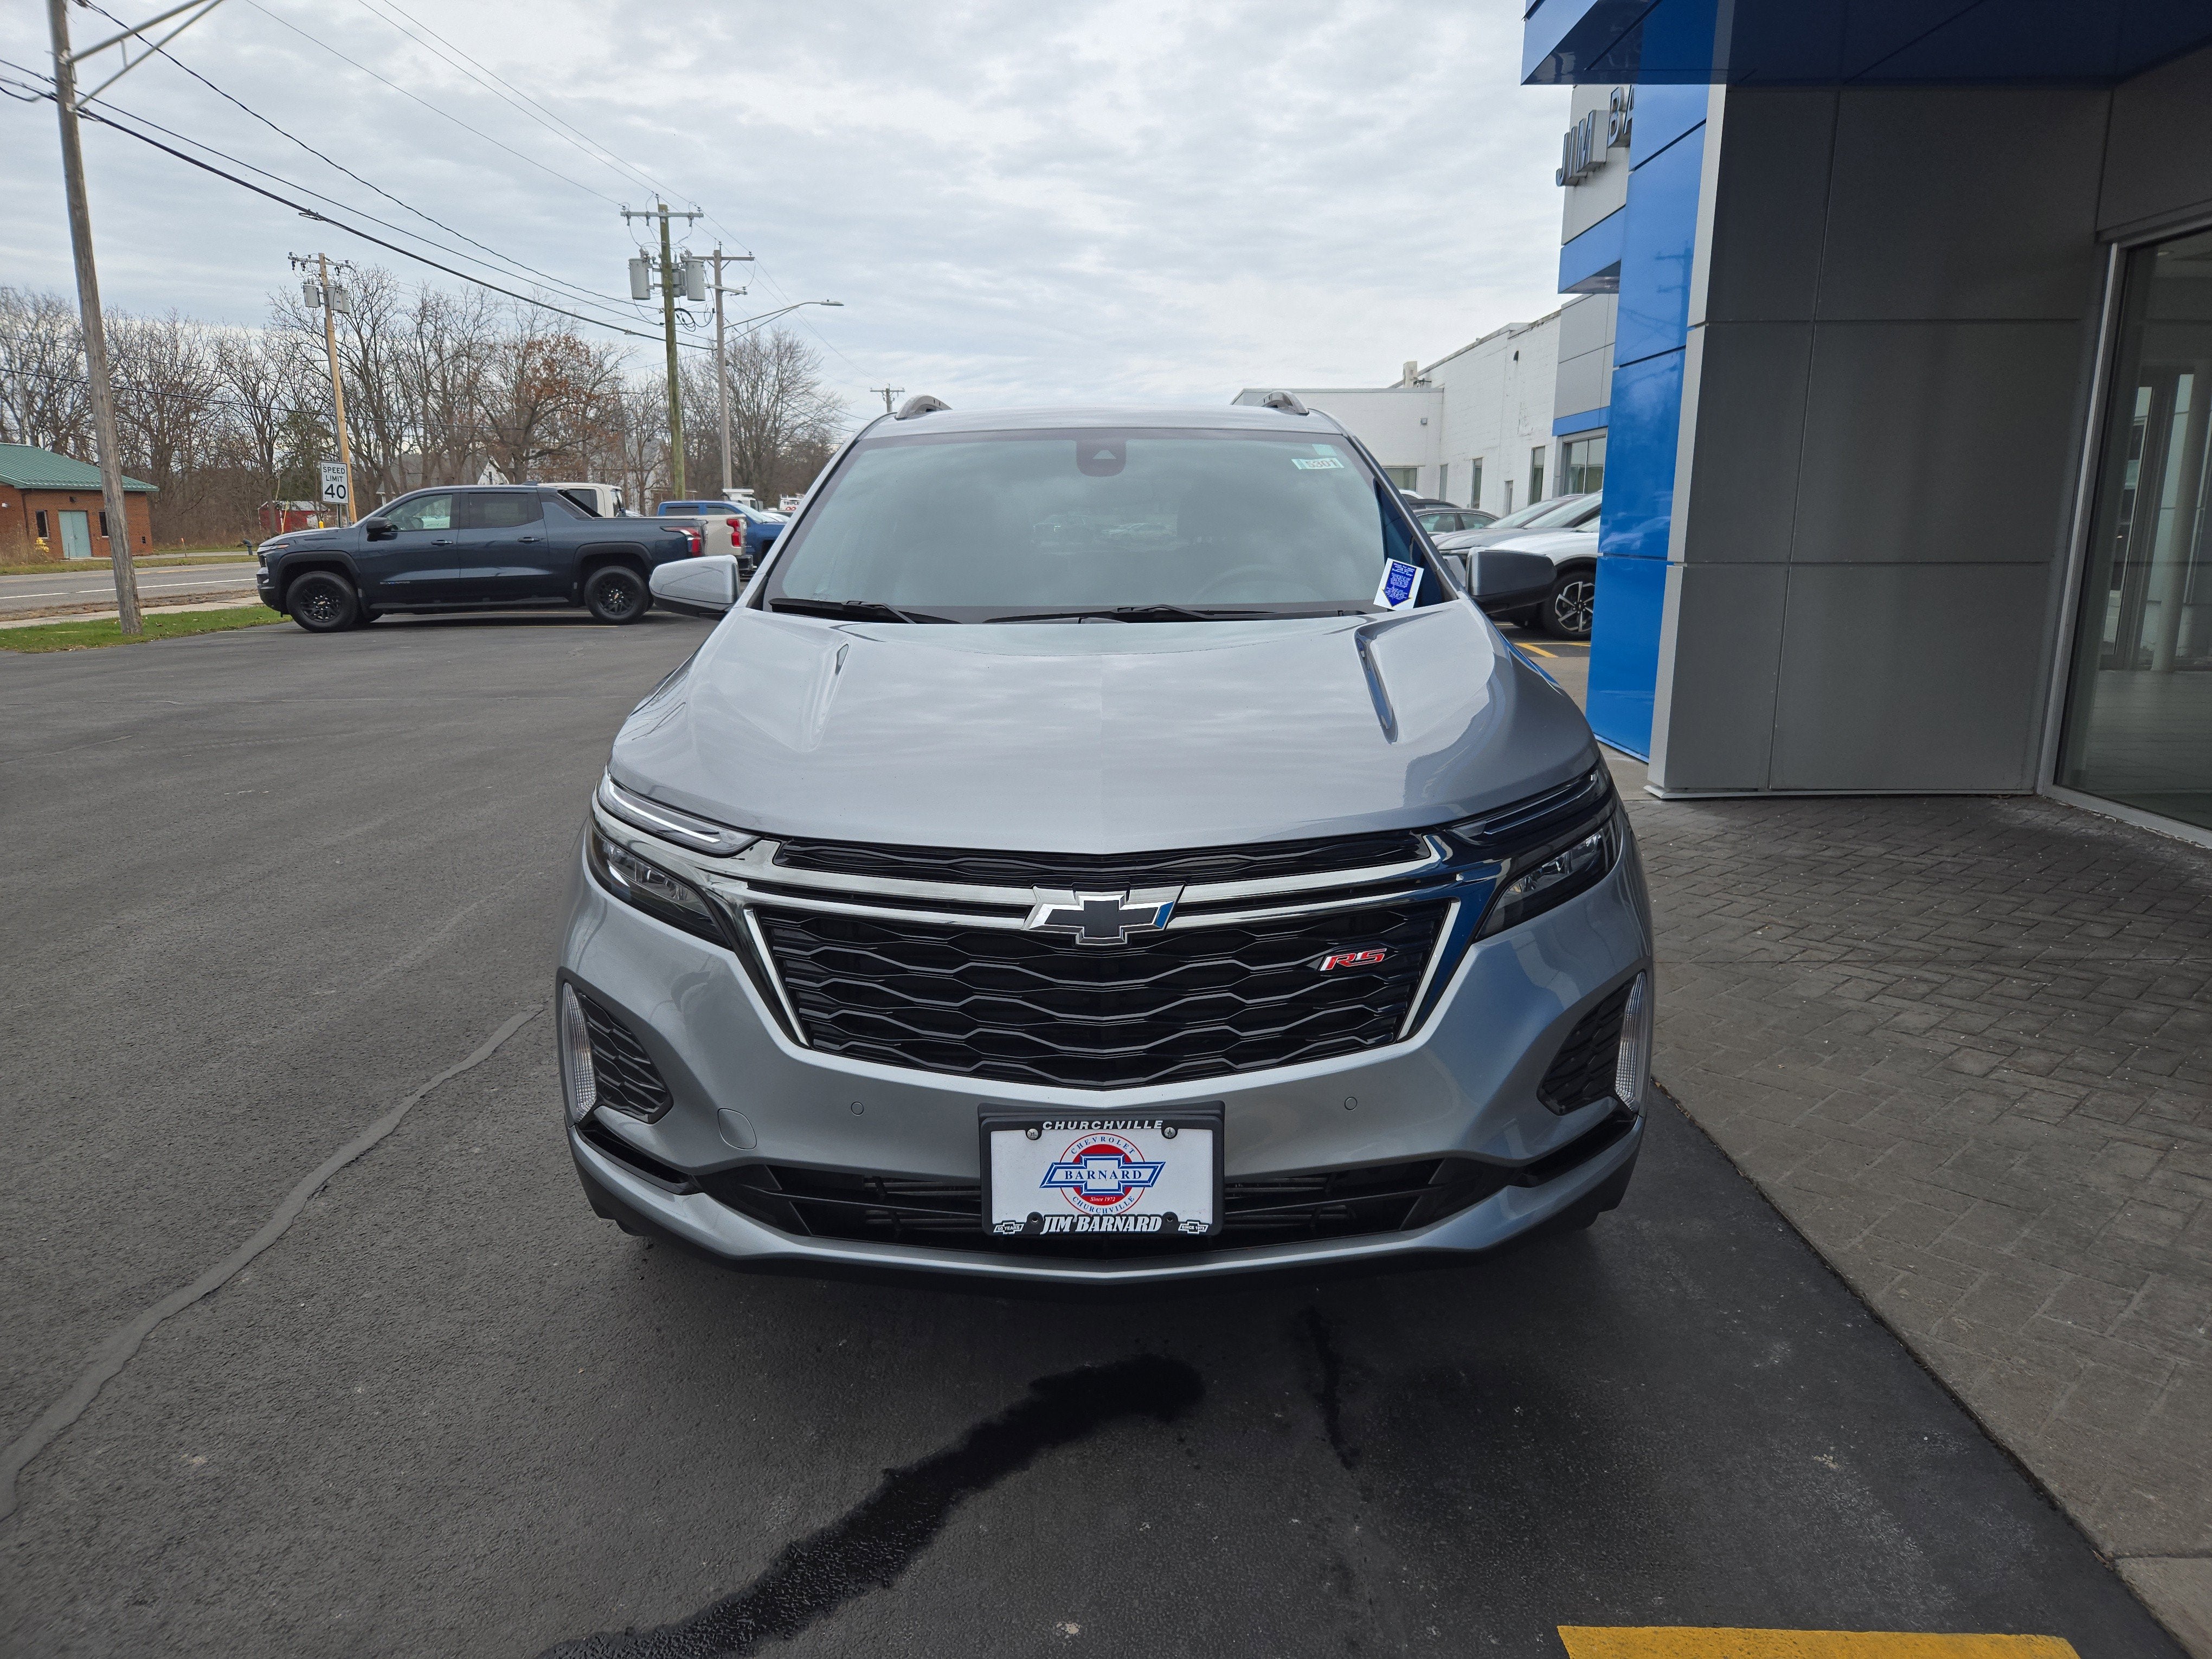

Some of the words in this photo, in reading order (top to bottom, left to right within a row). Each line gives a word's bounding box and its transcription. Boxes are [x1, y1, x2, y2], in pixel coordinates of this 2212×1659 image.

[1555, 110, 1603, 187] JIM
[323, 466, 345, 474] SPEED
[324, 484, 346, 499] 40
[1320, 948, 1387, 971] RS
[1043, 1120, 1163, 1130] CHURCHVILLE
[1071, 1136, 1135, 1154] CHEVROLET
[1065, 1170, 1142, 1180] BARNARD
[1072, 1196, 1135, 1214] CHURCHVILLE
[1039, 1216, 1073, 1235] JIM
[1075, 1216, 1162, 1232] BARNARD
